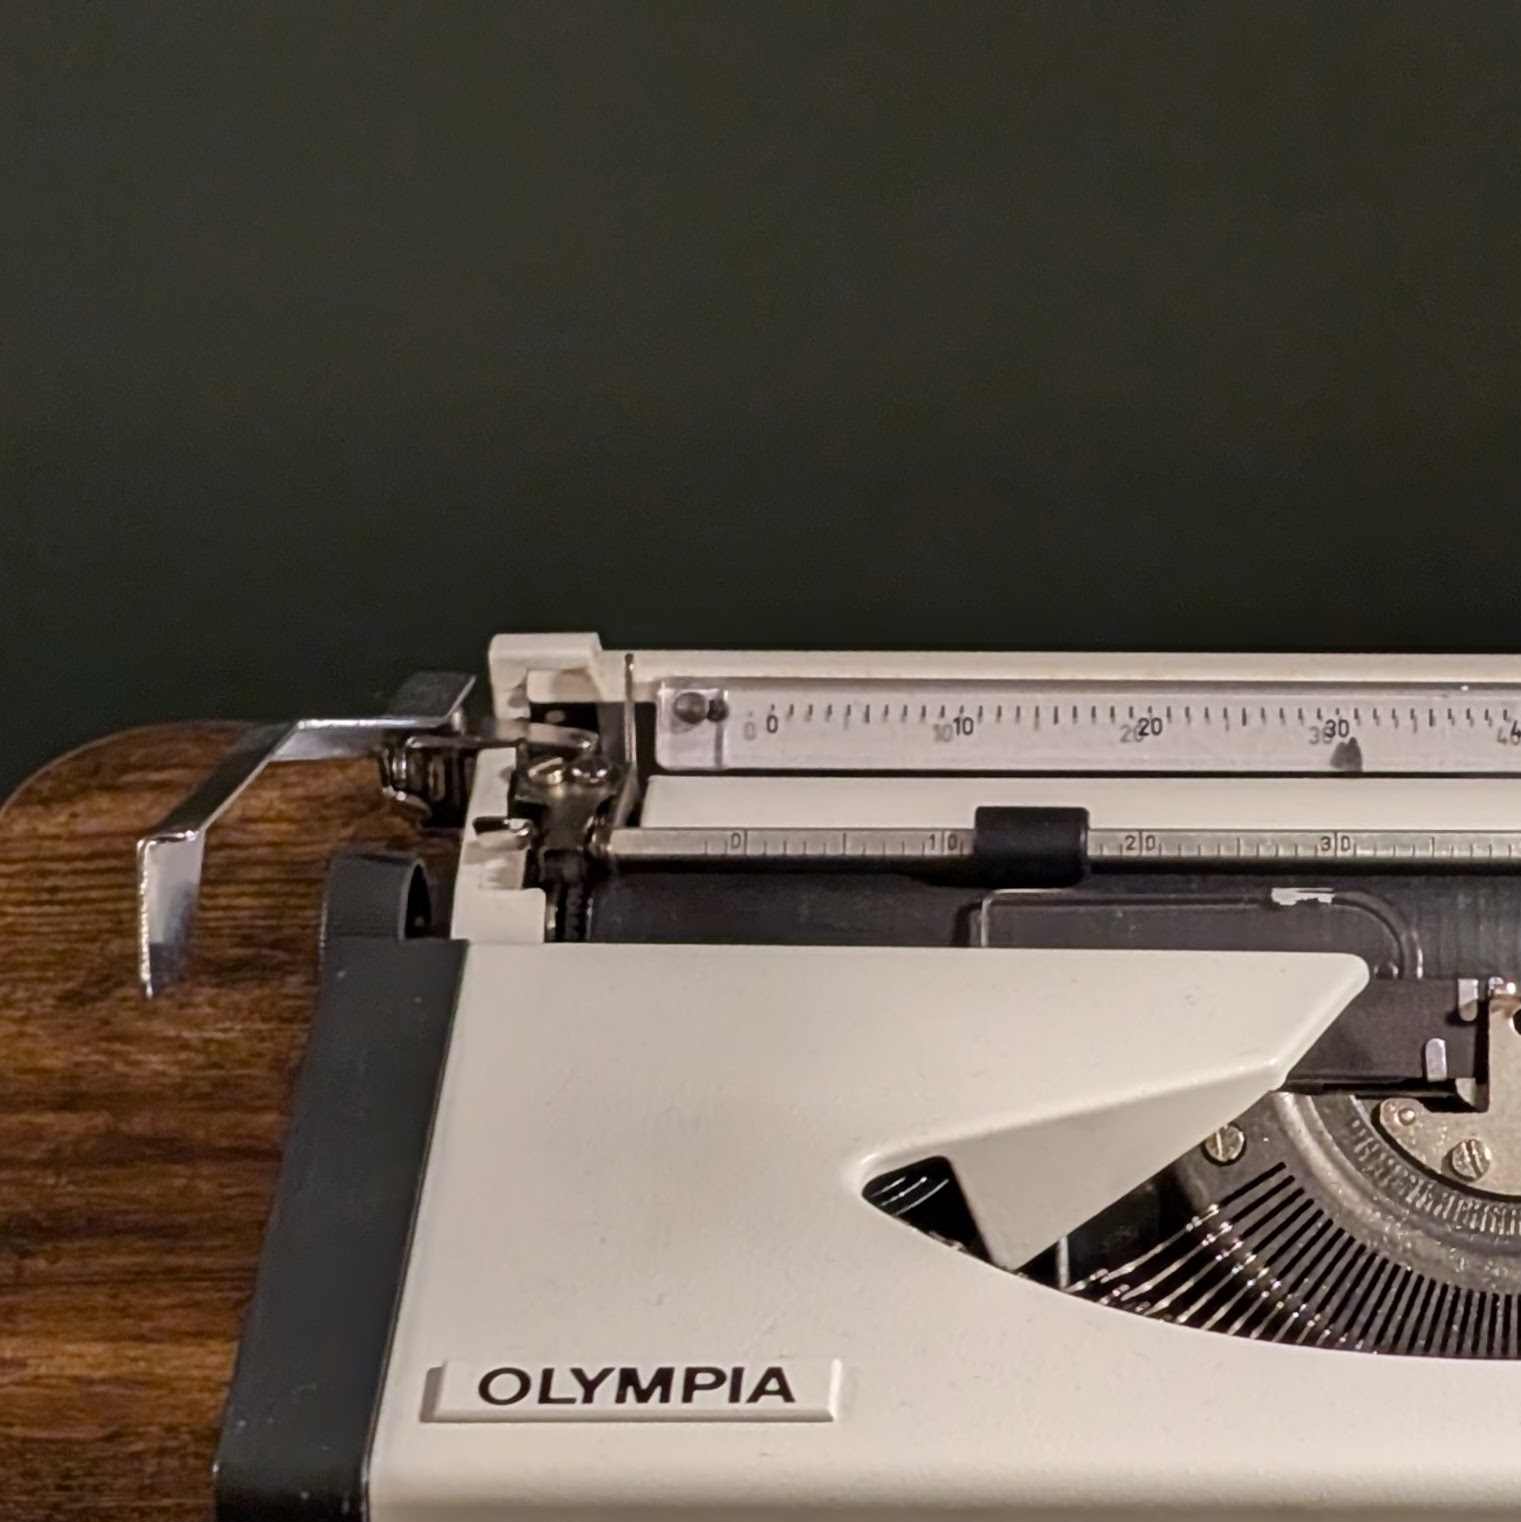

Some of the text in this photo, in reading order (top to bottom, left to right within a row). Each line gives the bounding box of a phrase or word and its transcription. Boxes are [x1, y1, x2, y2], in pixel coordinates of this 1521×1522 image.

[765, 714, 780, 734] 0
[953, 715, 976, 737] 10
[1138, 717, 1164, 737] 20
[1324, 719, 1351, 738] 30
[478, 1367, 796, 1406] OLYMPIA
